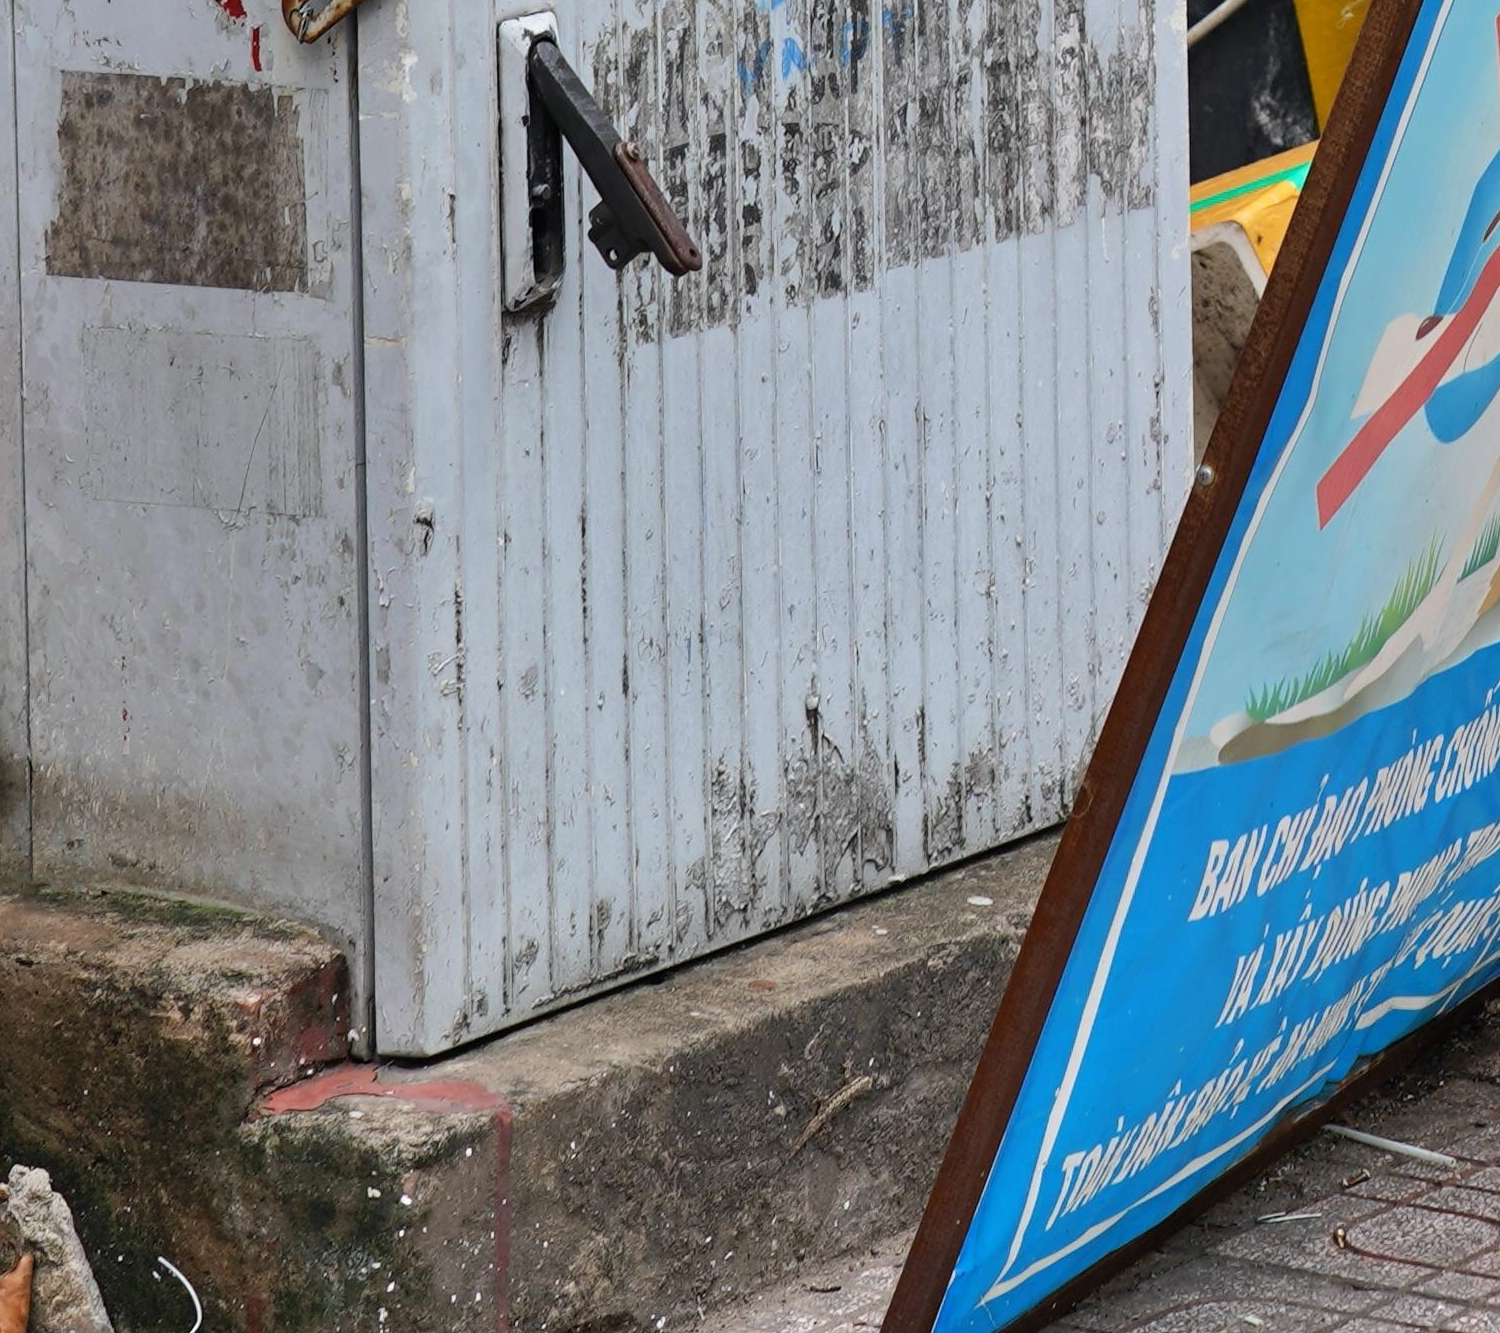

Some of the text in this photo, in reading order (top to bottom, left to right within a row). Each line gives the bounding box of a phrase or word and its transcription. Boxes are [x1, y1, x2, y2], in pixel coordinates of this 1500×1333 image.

[1189, 826, 1266, 920] BAN
[1257, 776, 1328, 895] CHỈ
[1300, 779, 1367, 876] ĐẠO
[1352, 730, 1443, 841] PHÒNG
[1218, 924, 1268, 1025] VÀ
[1303, 880, 1389, 978] DỰNG
[1047, 1119, 1135, 1228] TOÀN
[1113, 1083, 1193, 1183] DÂN
[1169, 1040, 1246, 1147] BẢO
